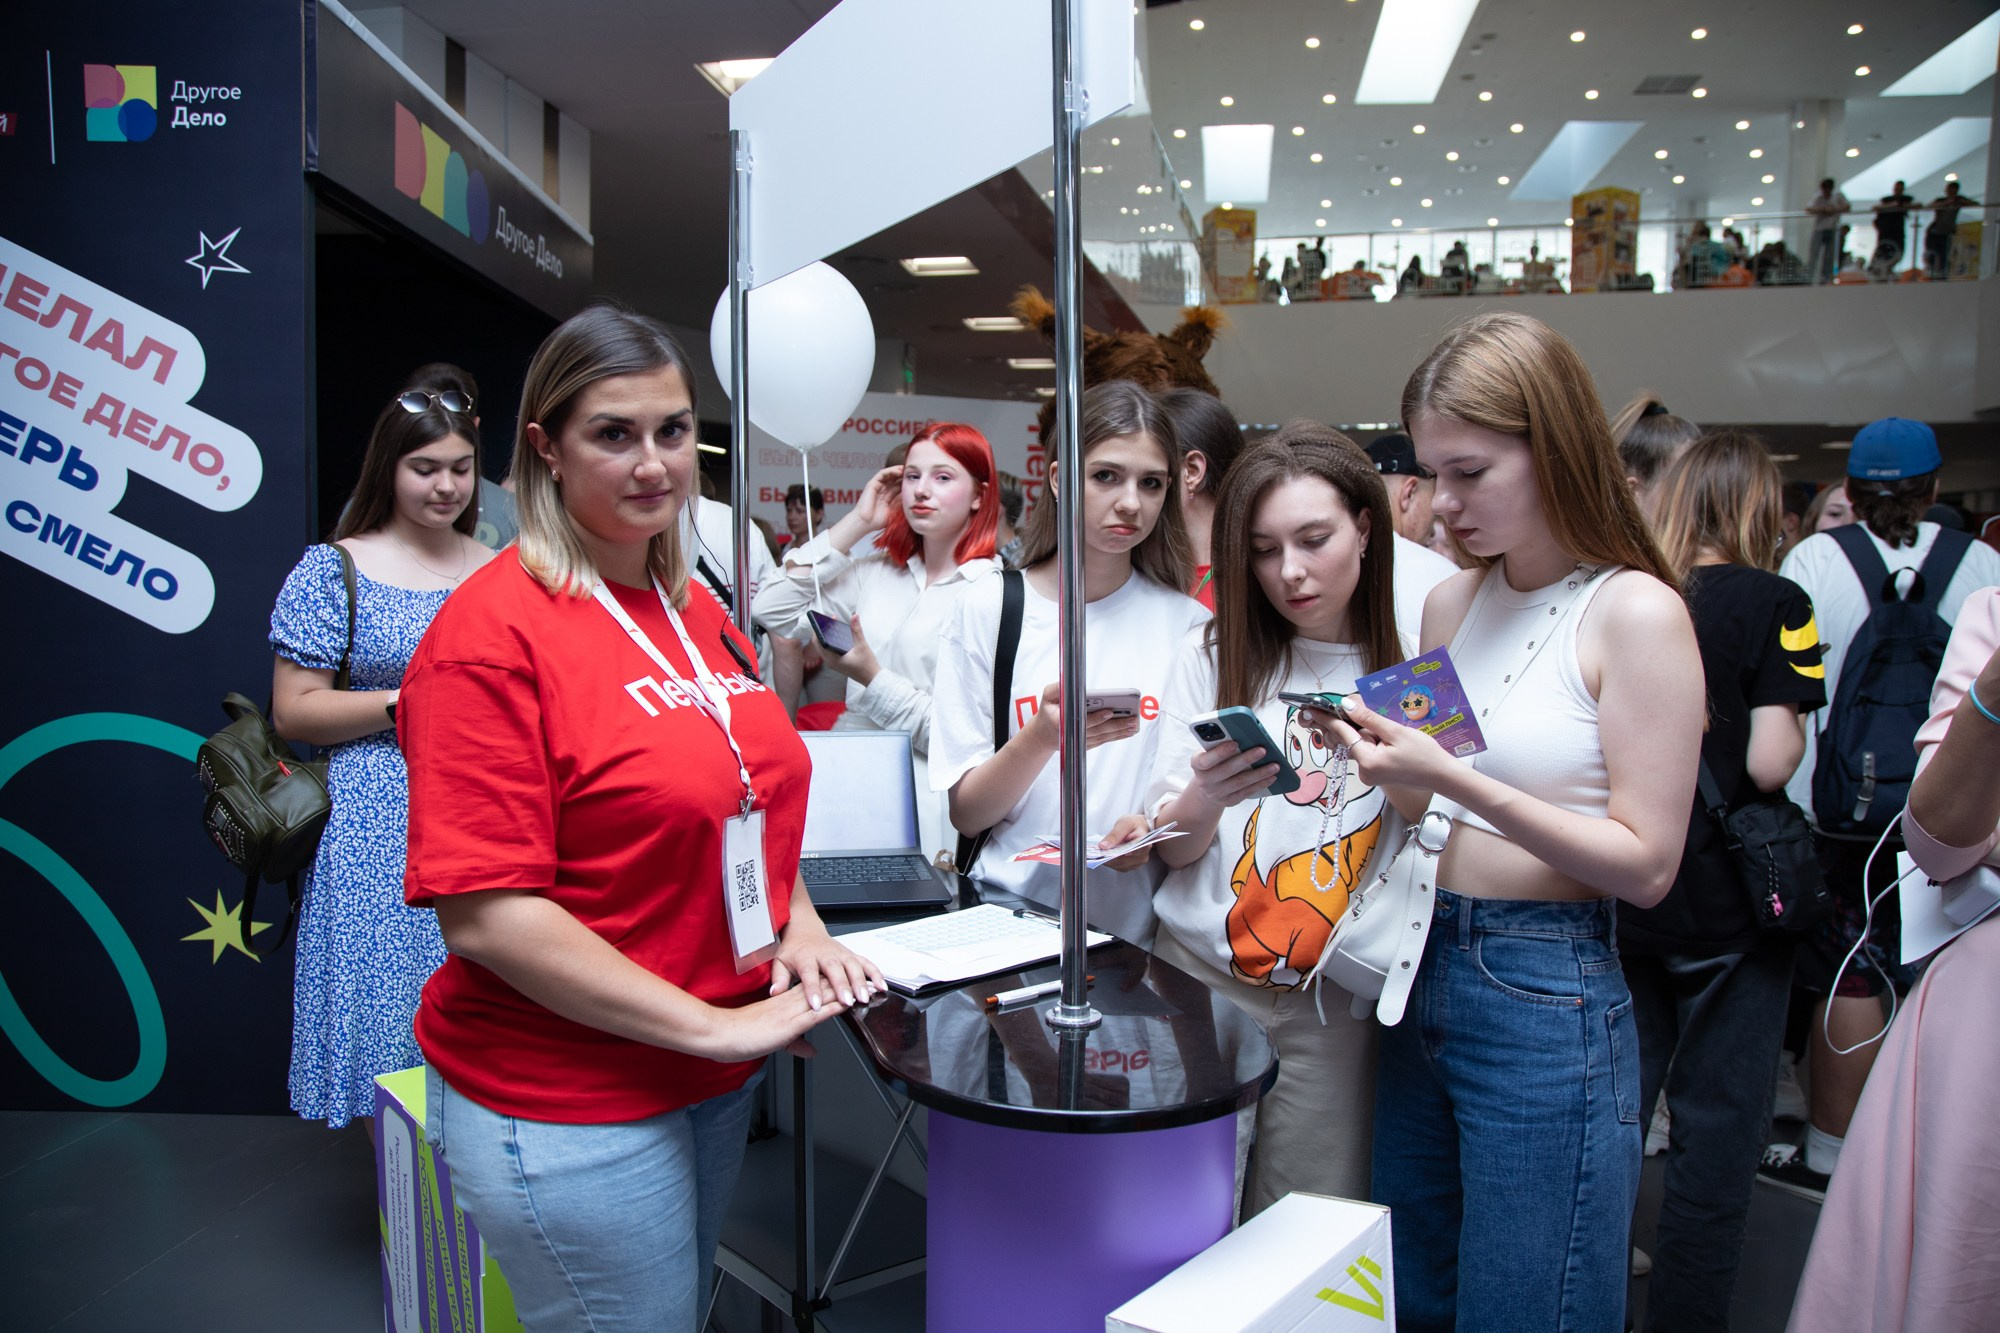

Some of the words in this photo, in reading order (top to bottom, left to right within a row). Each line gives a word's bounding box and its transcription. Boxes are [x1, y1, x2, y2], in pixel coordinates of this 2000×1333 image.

[171, 80, 242, 103] Другое
[171, 106, 227, 128] Дело
[495, 204, 536, 259] Другое
[536, 234, 563, 279] Дело
[82, 392, 231, 492] ДЕЛО,
[5, 500, 179, 601] СМЕЛО
[437, 1219, 454, 1289] МЕНЯЙ
[455, 1208, 470, 1281] МЕНЯЙ
